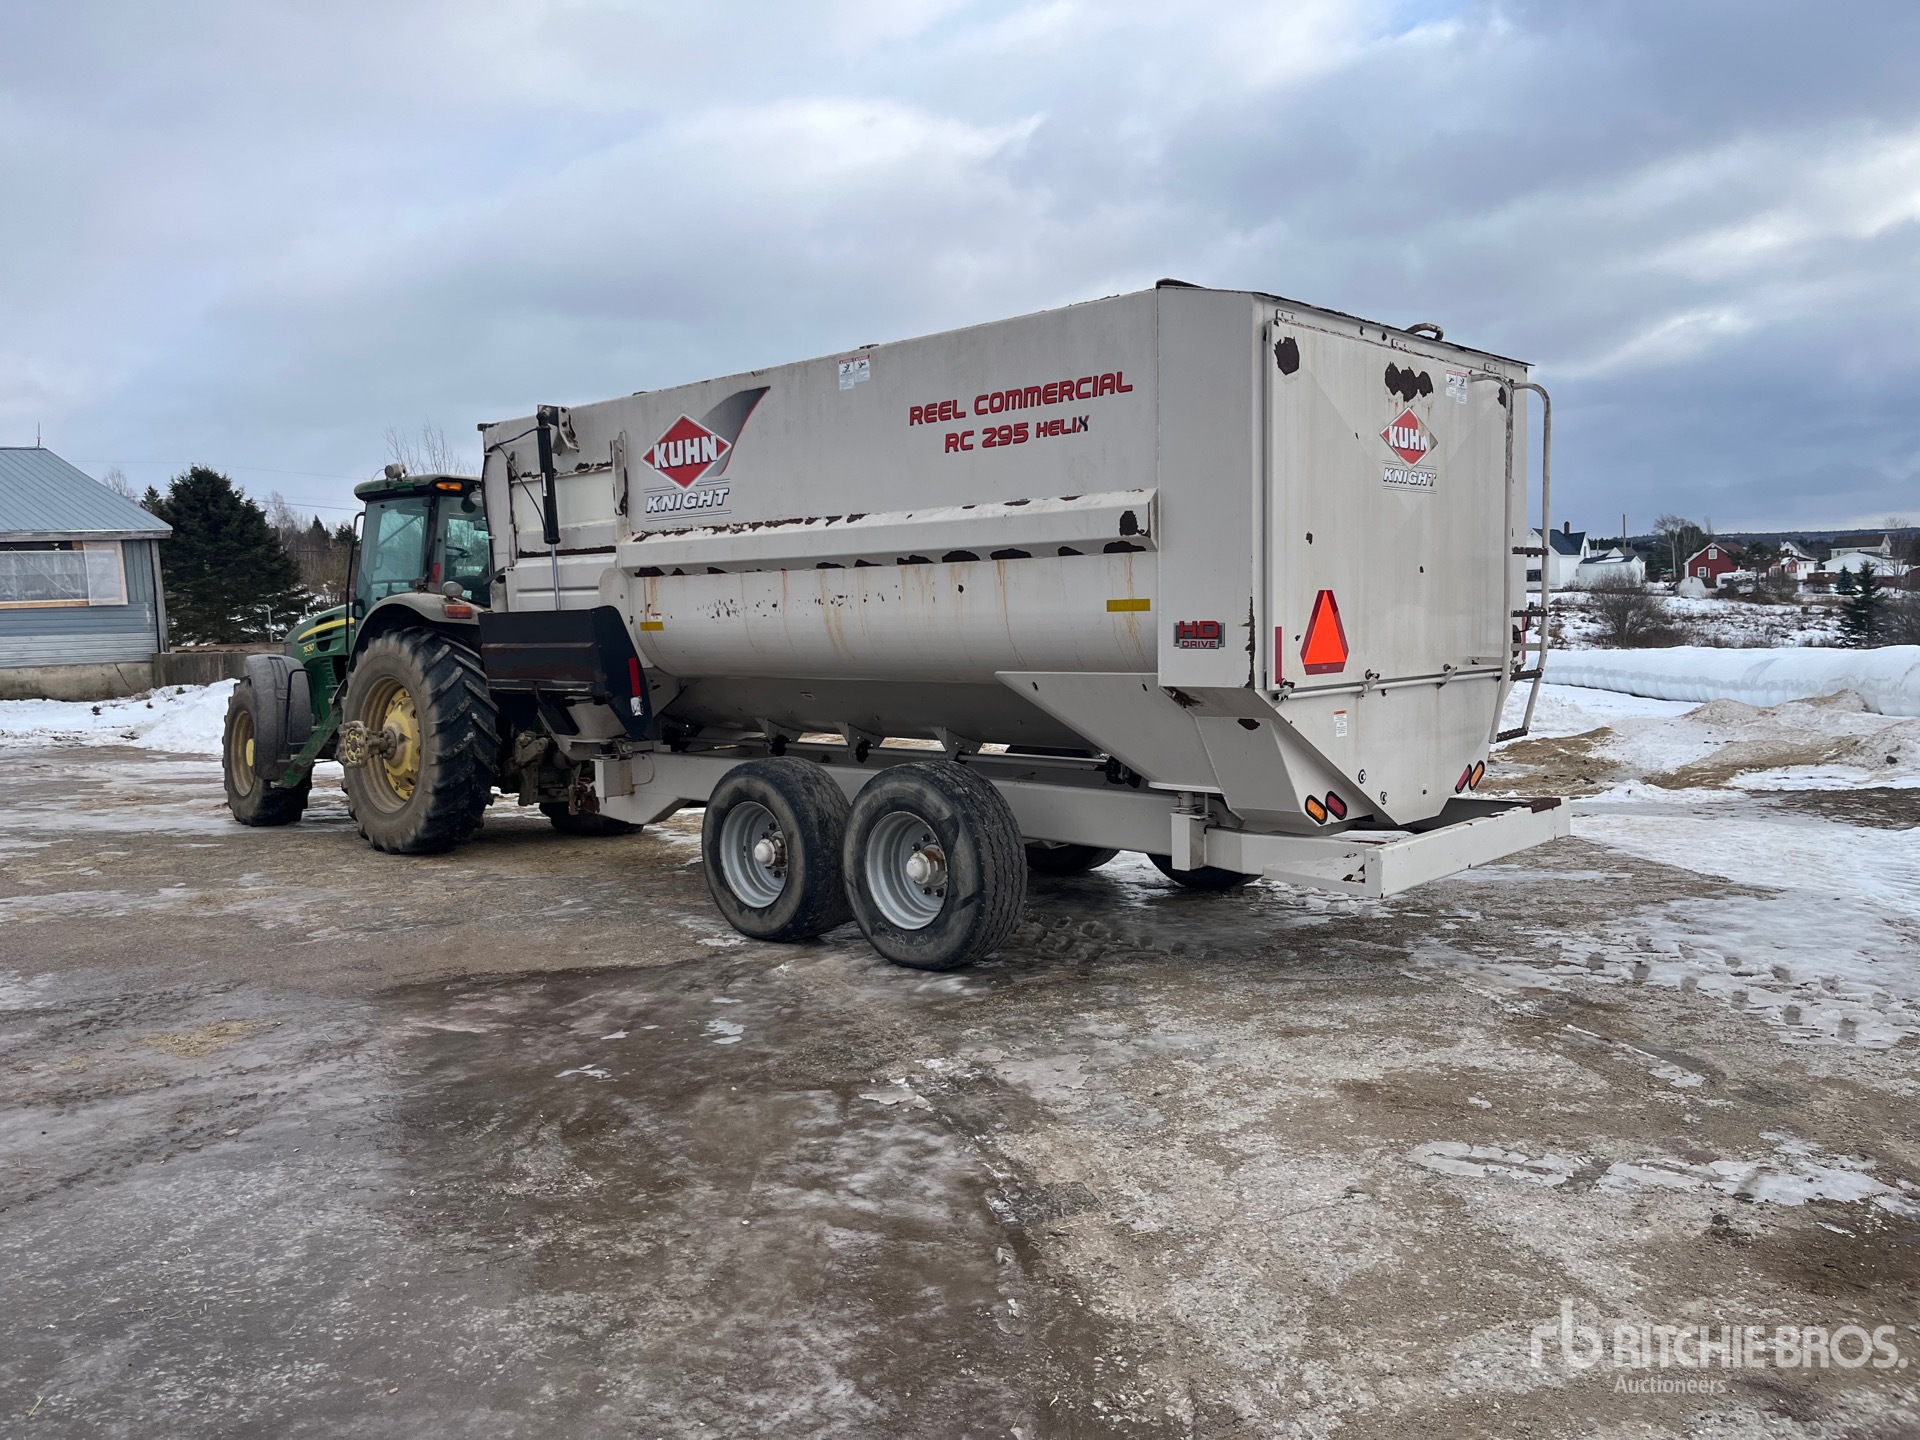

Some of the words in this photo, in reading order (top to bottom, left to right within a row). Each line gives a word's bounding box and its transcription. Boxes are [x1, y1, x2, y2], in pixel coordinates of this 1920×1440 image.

[909, 399, 966, 426] REEL
[973, 371, 1133, 415] COMMERCIAL
[944, 430, 974, 453] RC
[981, 422, 1029, 448] 295
[1035, 415, 1090, 438] HELIX
[1388, 425, 1428, 452] KUHN
[653, 435, 718, 470] KUHN
[1383, 468, 1436, 487] KNIGHT
[646, 487, 729, 513] KNIGHT
[1178, 620, 1220, 639] HD
[1181, 640, 1216, 648] DRIVE
